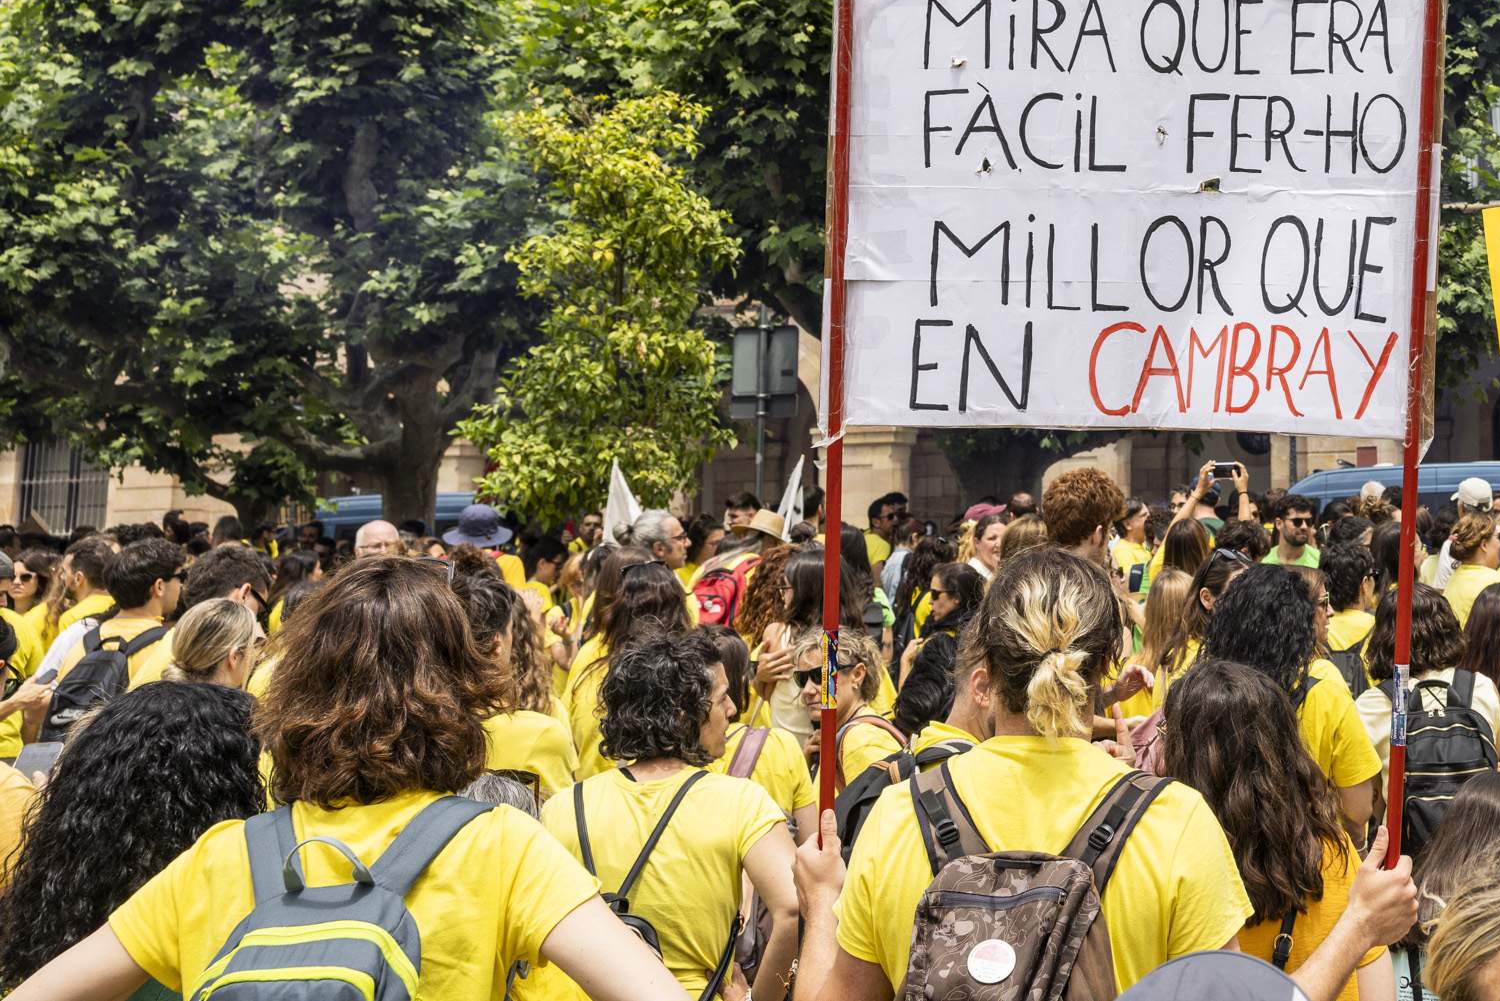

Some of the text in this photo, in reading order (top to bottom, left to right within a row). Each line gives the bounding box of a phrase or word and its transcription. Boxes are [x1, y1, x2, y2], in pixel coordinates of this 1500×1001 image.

[1185, 91, 1408, 174] FER-HO
[1261, 214, 1398, 323] QUE
[908, 318, 1400, 421] EN CAMBRAY
